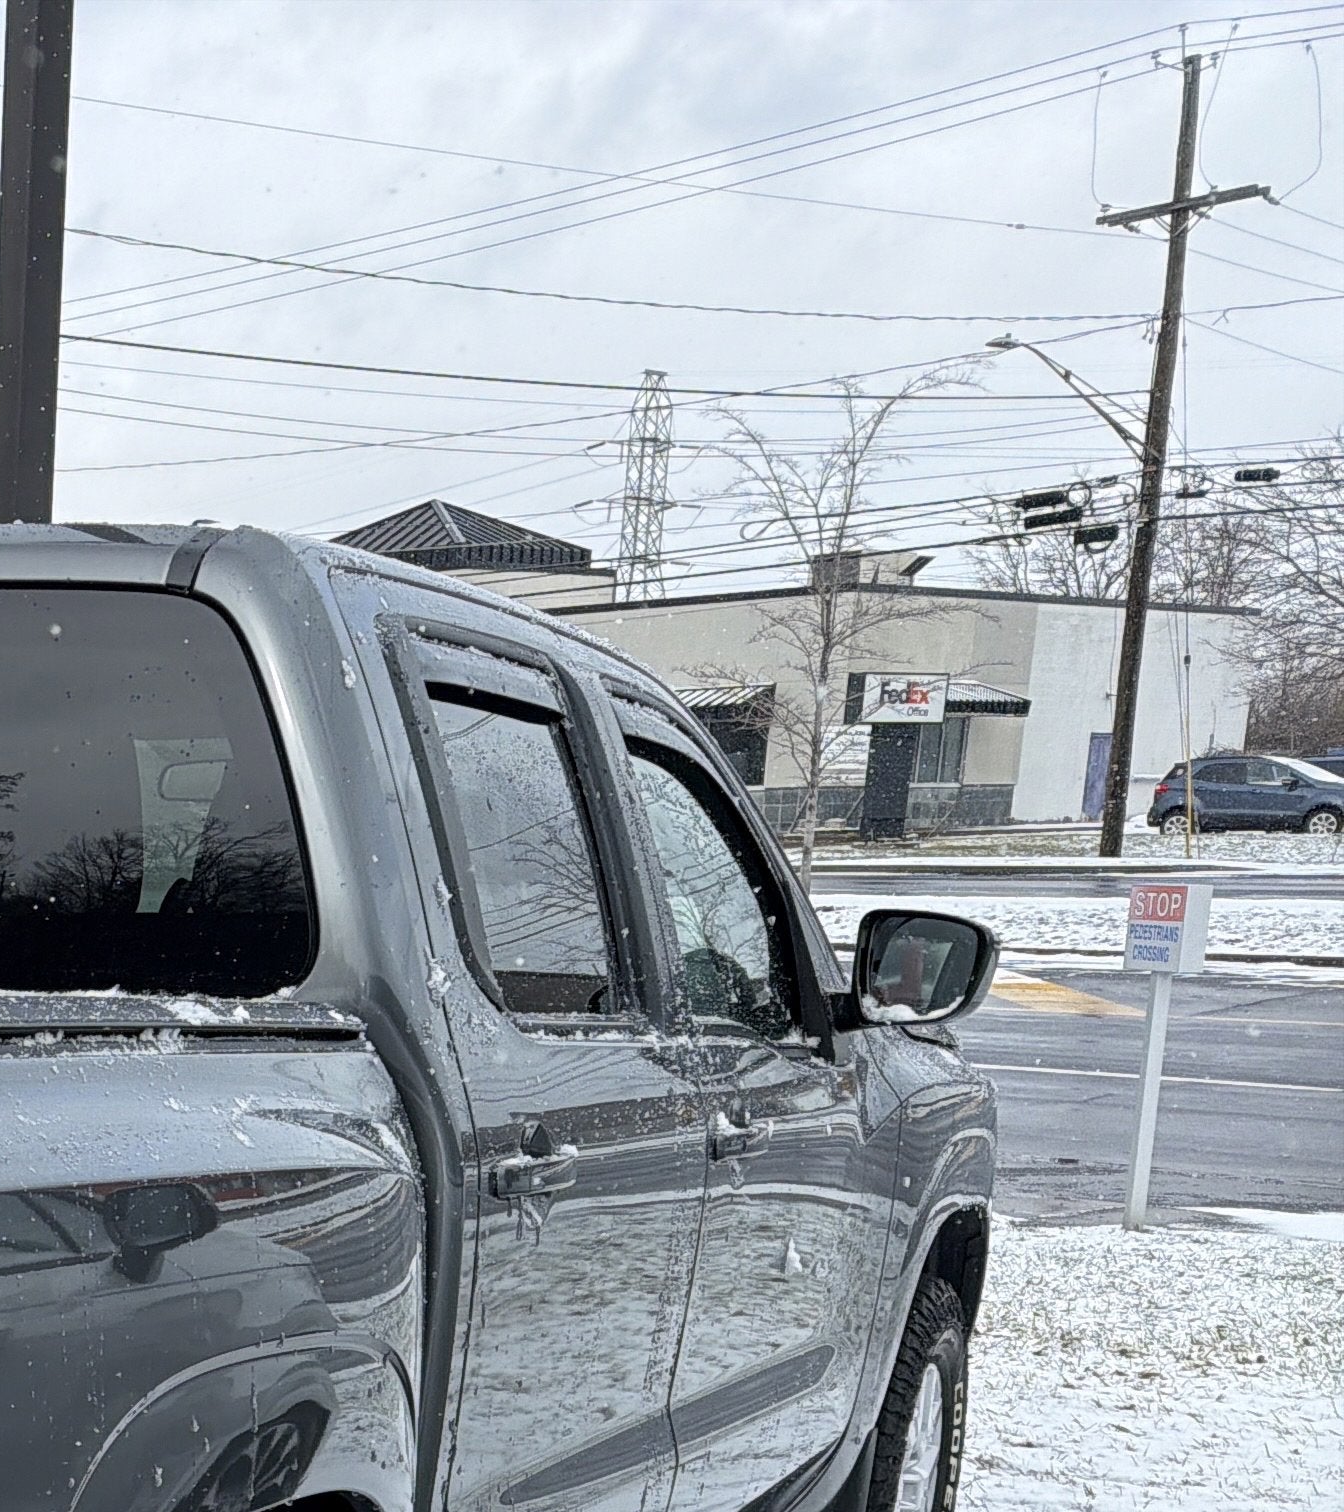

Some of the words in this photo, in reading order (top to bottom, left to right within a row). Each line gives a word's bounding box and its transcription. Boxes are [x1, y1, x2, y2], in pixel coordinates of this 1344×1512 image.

[1135, 891, 1182, 917] STOP
[1129, 923, 1179, 943] PEDESTRIANS
[1132, 944, 1170, 963] CROSSING
